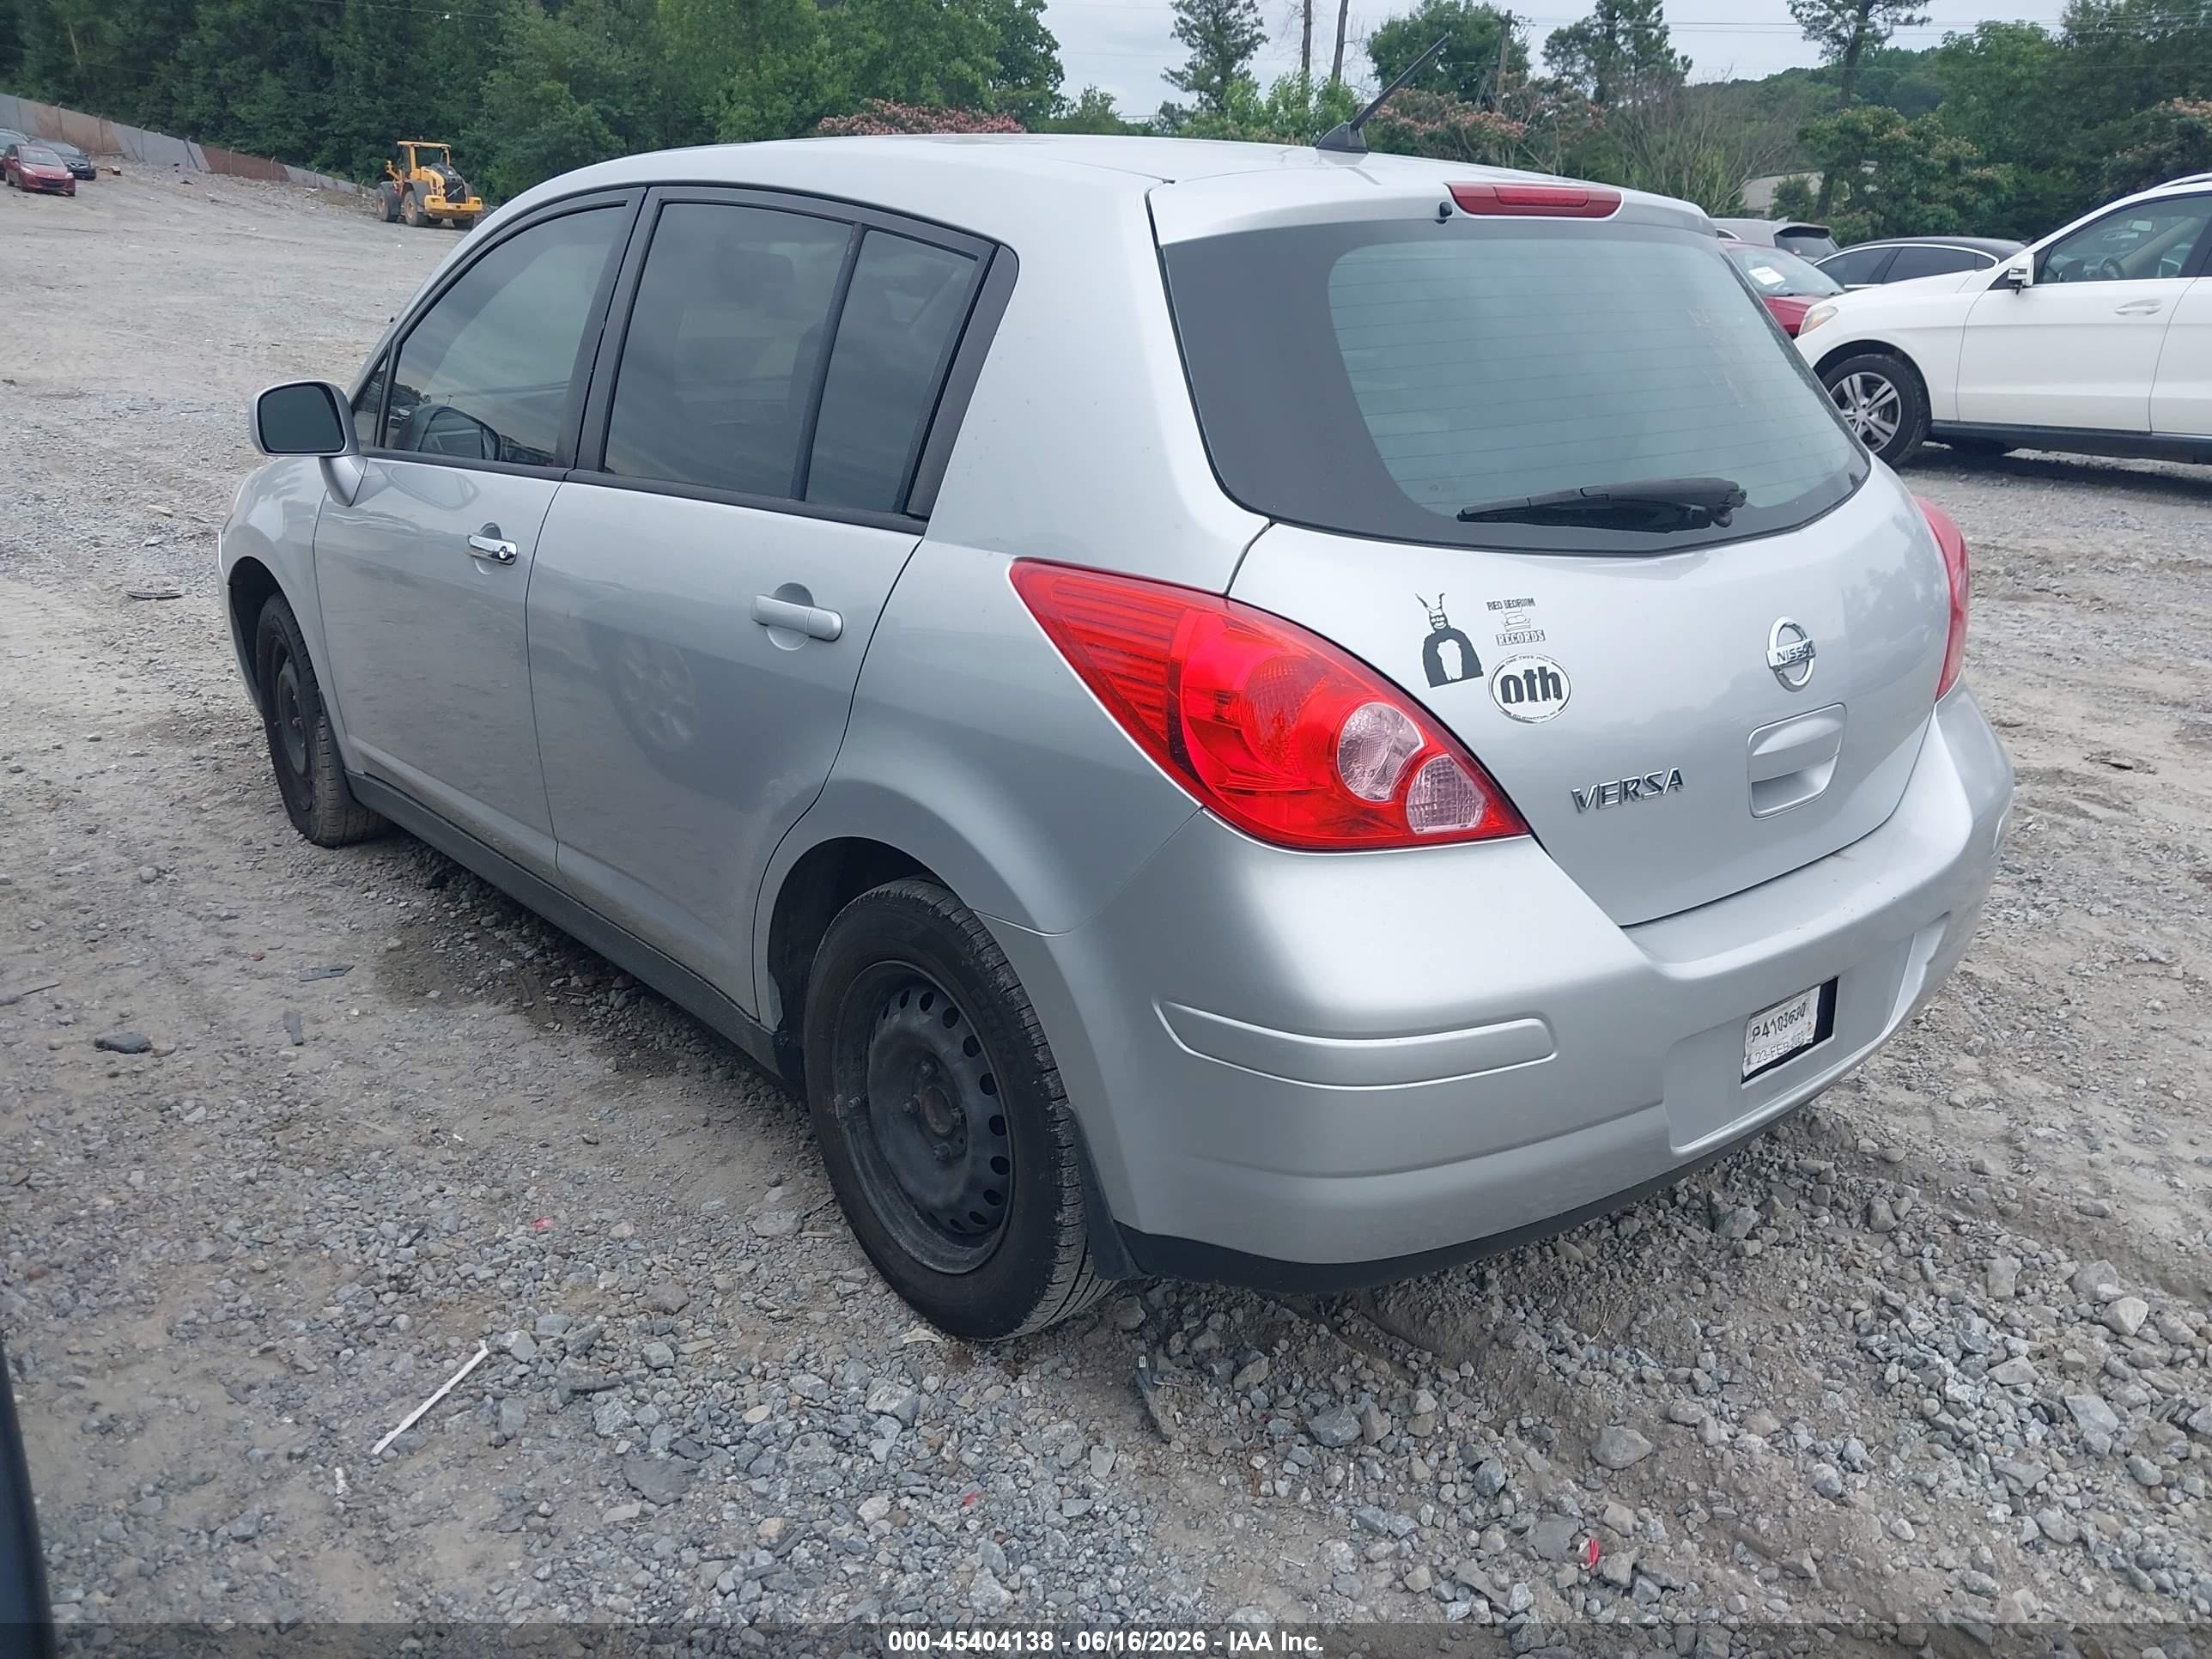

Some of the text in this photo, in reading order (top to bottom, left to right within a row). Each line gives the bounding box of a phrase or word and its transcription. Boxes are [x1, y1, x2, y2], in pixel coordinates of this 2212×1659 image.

[1497, 629, 1546, 647] RECORDS
[1500, 666, 1563, 704] oth
[1571, 767, 1684, 813] VERSA
